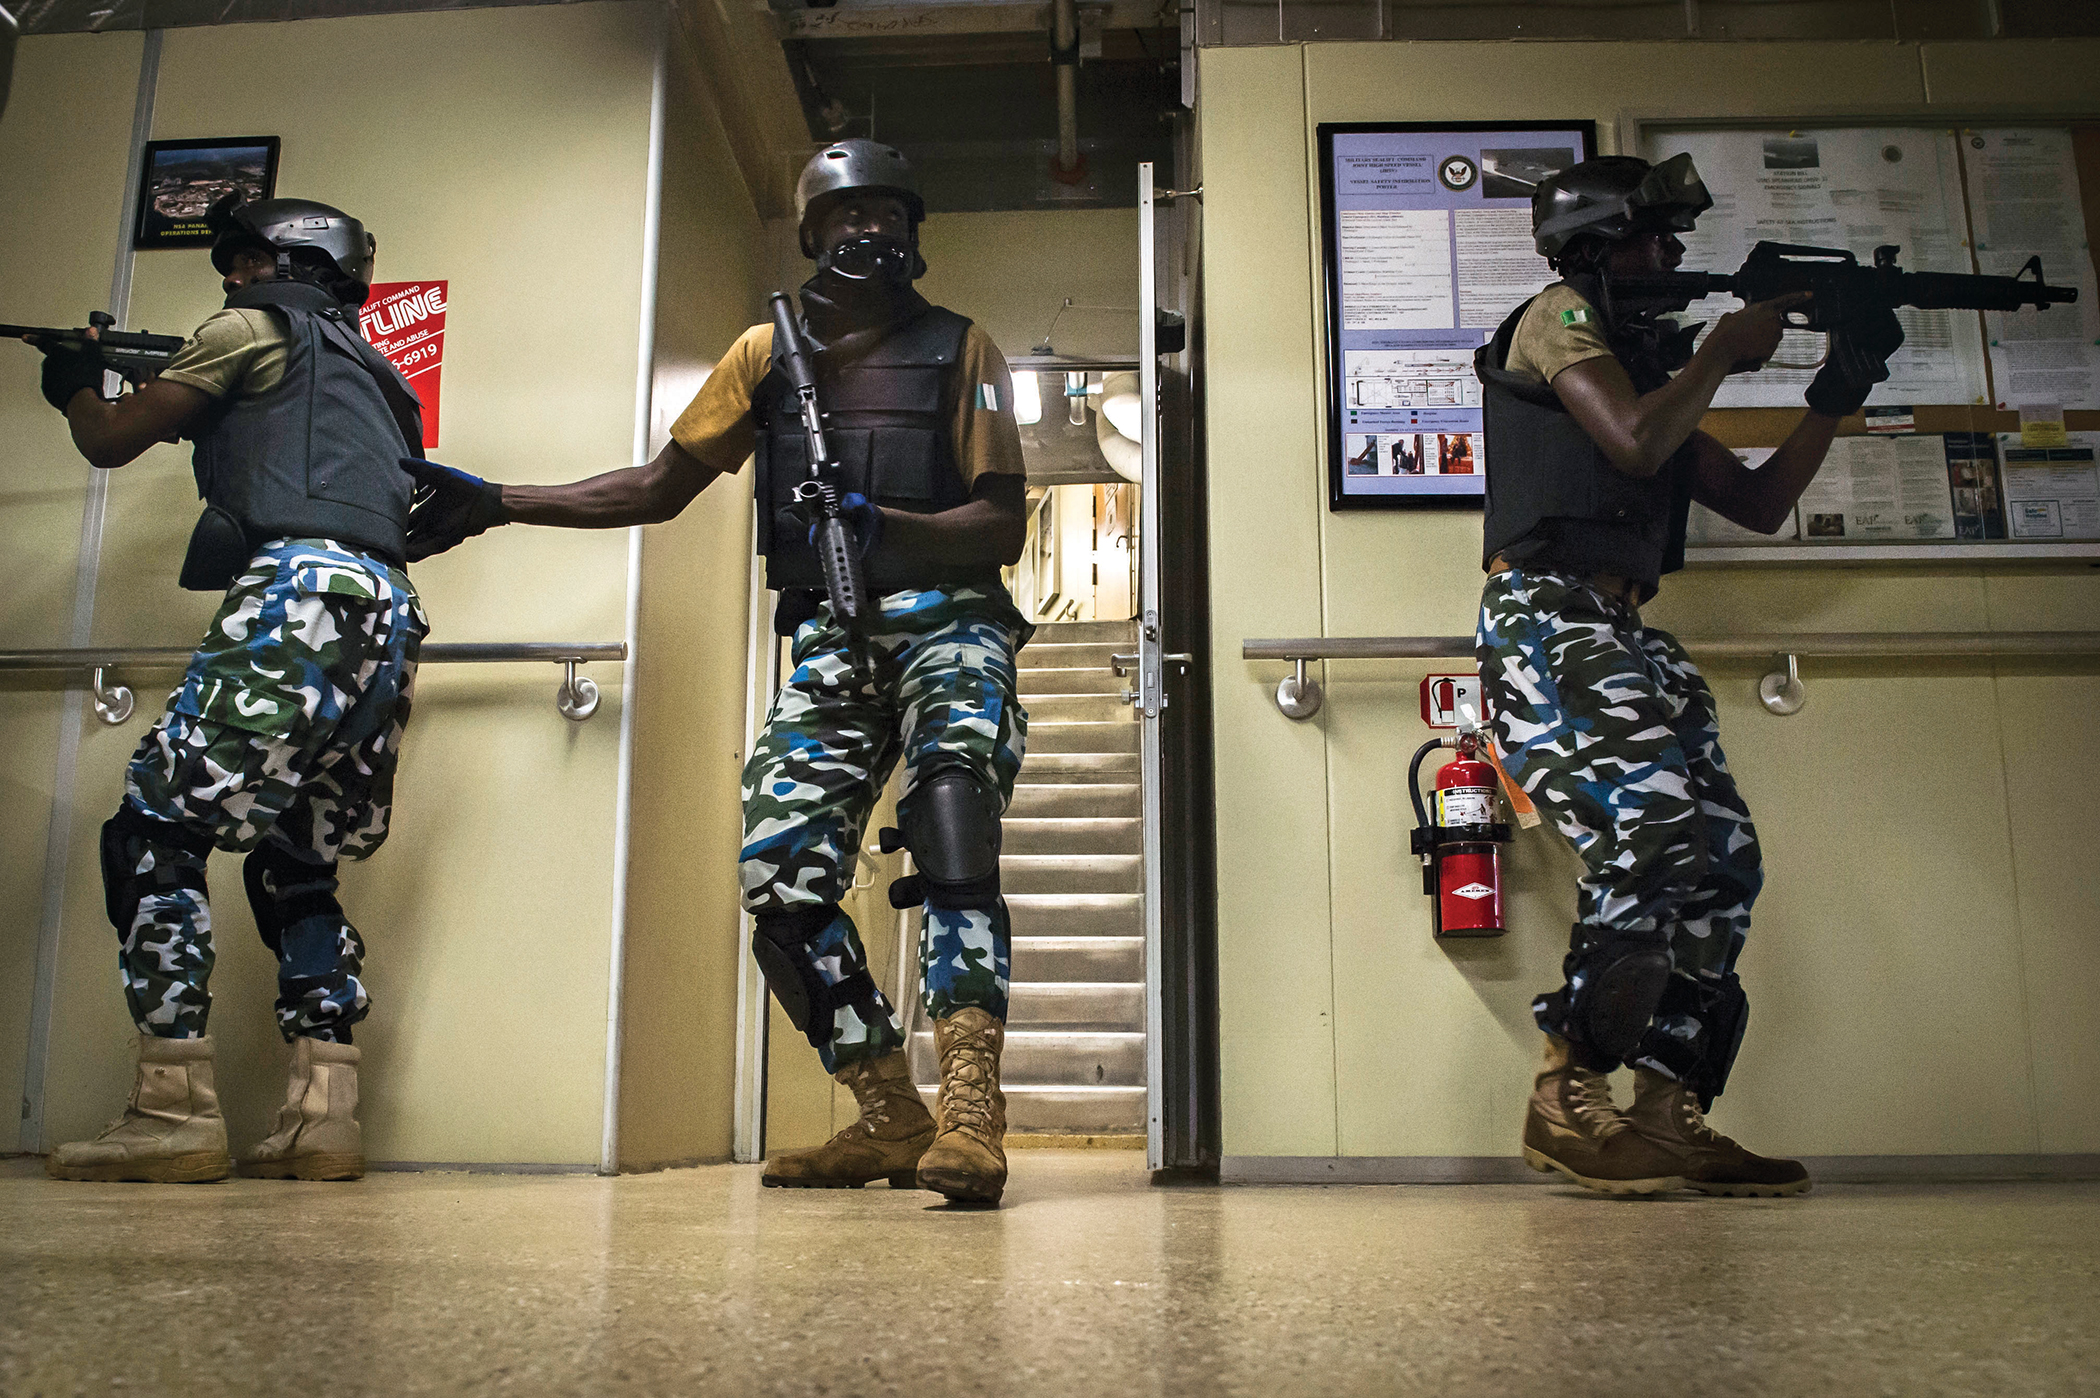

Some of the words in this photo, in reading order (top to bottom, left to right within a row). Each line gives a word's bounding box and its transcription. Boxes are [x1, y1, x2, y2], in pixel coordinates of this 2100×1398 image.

[382, 285, 420, 305] COMMAND
[390, 339, 406, 351] AND
[406, 328, 429, 344] ABUSE
[1457, 688, 1467, 698] P
